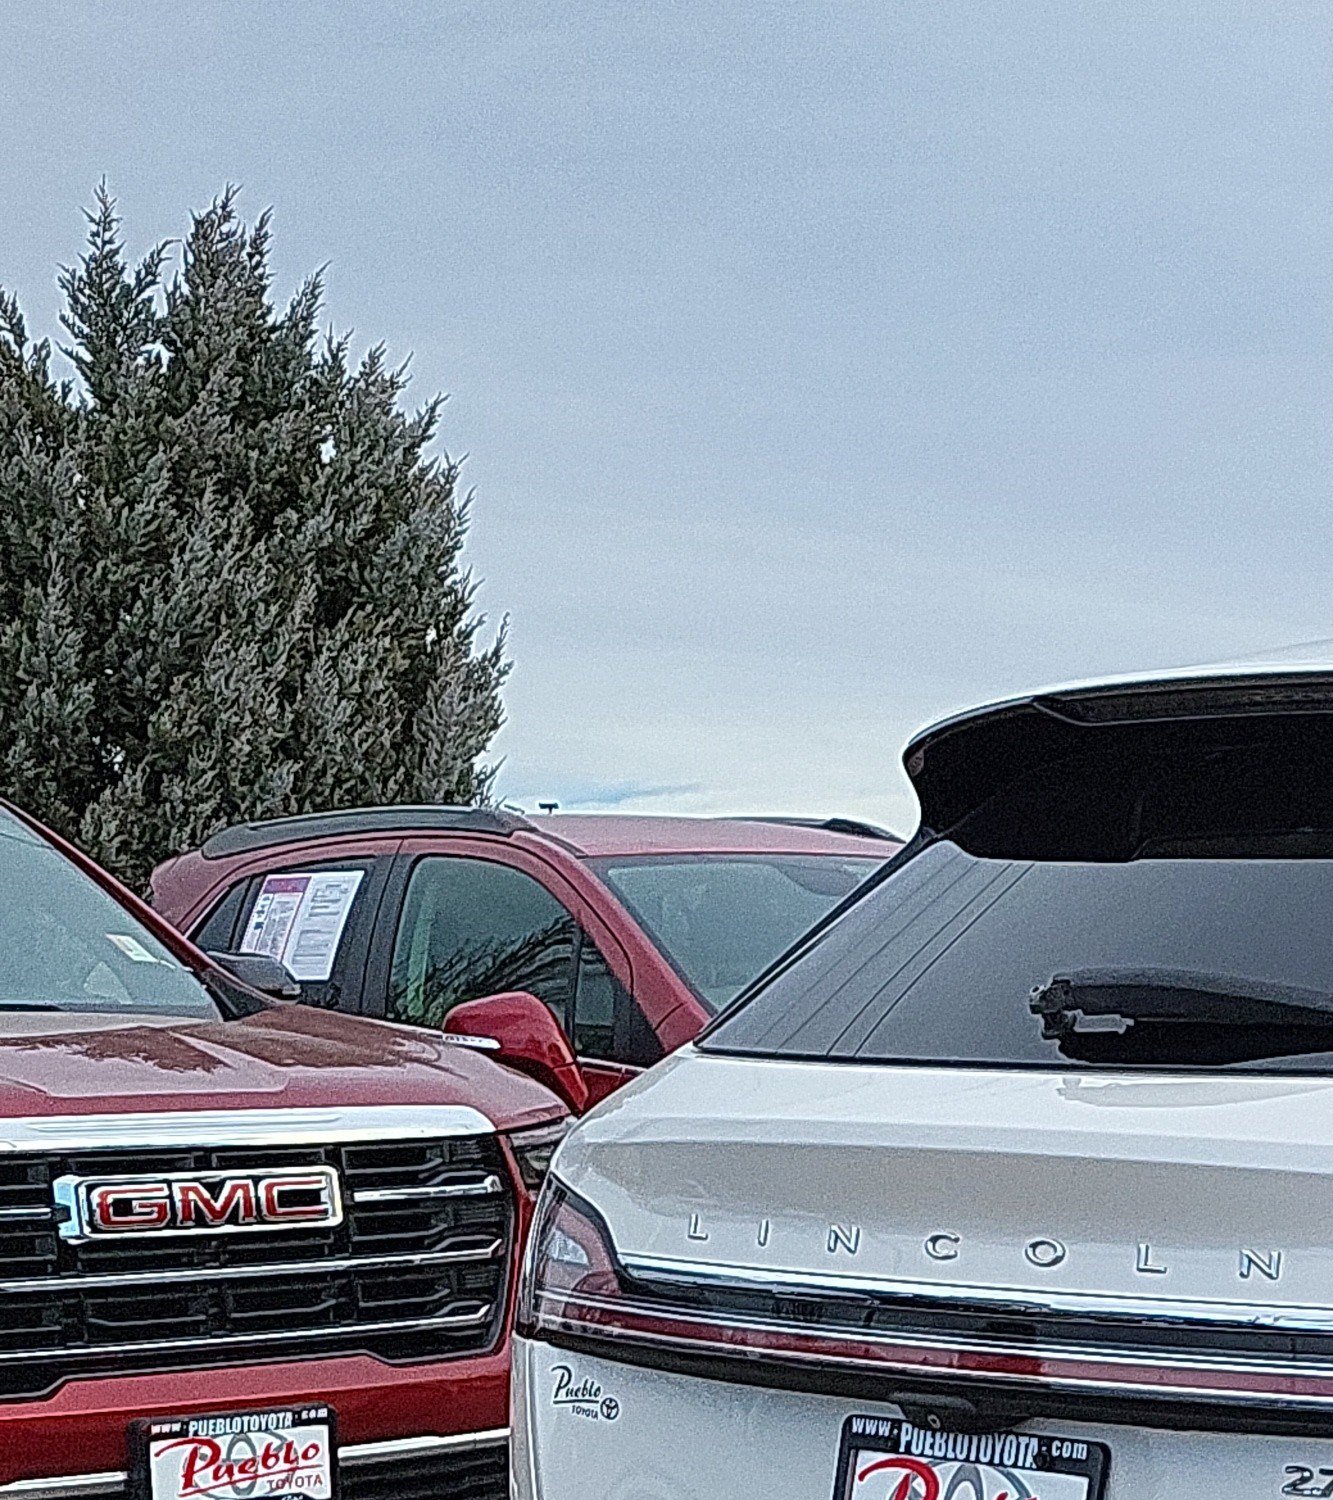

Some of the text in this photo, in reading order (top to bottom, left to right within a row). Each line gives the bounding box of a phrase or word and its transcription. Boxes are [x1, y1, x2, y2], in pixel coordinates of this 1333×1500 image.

[91, 1176, 330, 1230] GMC
[687, 1213, 1283, 1281] LINCOLN
[550, 1365, 602, 1399] Pueblo
[571, 1404, 599, 1420] TOYOTA
[154, 1437, 321, 1490] Pueblo
[266, 1474, 323, 1492] TOYOTA
